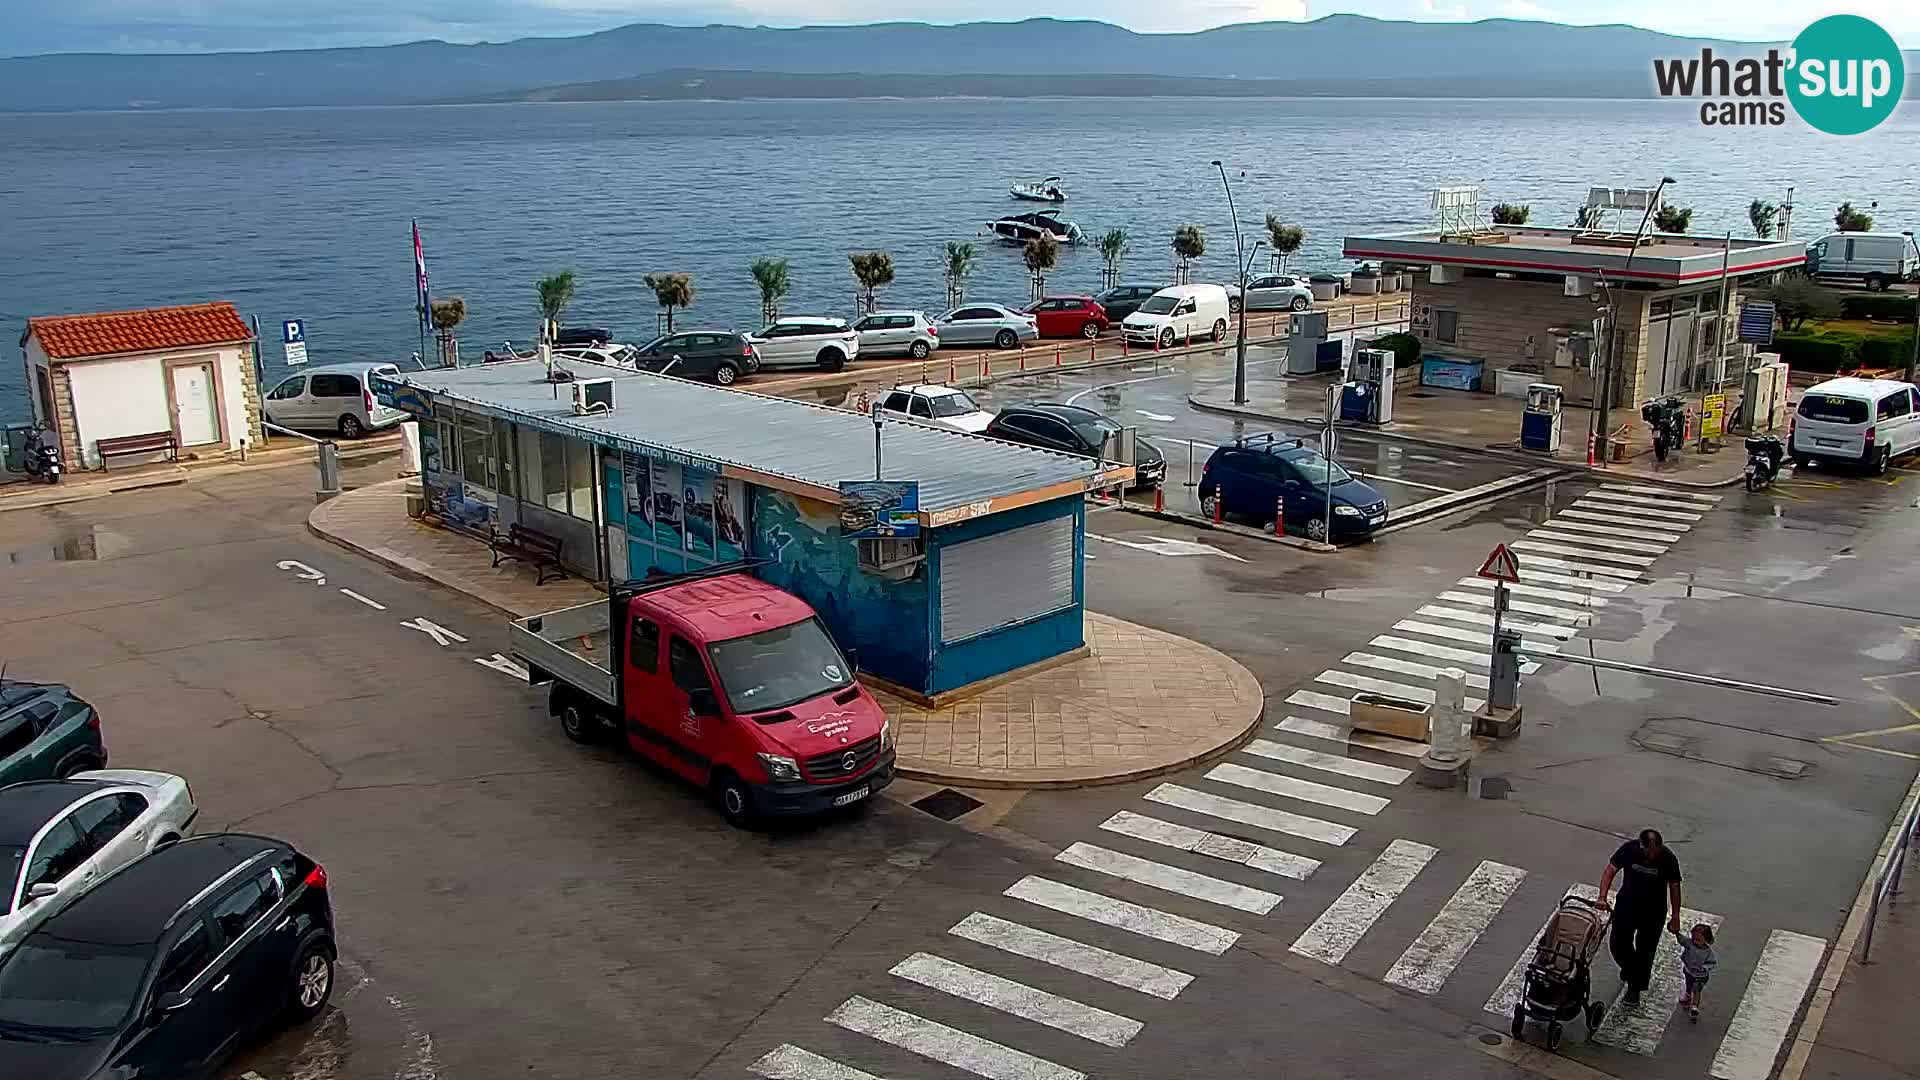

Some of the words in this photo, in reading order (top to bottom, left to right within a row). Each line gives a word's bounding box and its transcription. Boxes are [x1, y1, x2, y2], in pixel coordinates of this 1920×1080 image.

[288, 322, 299, 340] P
[616, 439, 633, 451] BUS
[633, 444, 663, 459] STATION
[665, 451, 690, 465] TICKET
[692, 458, 718, 472] OFFICE
